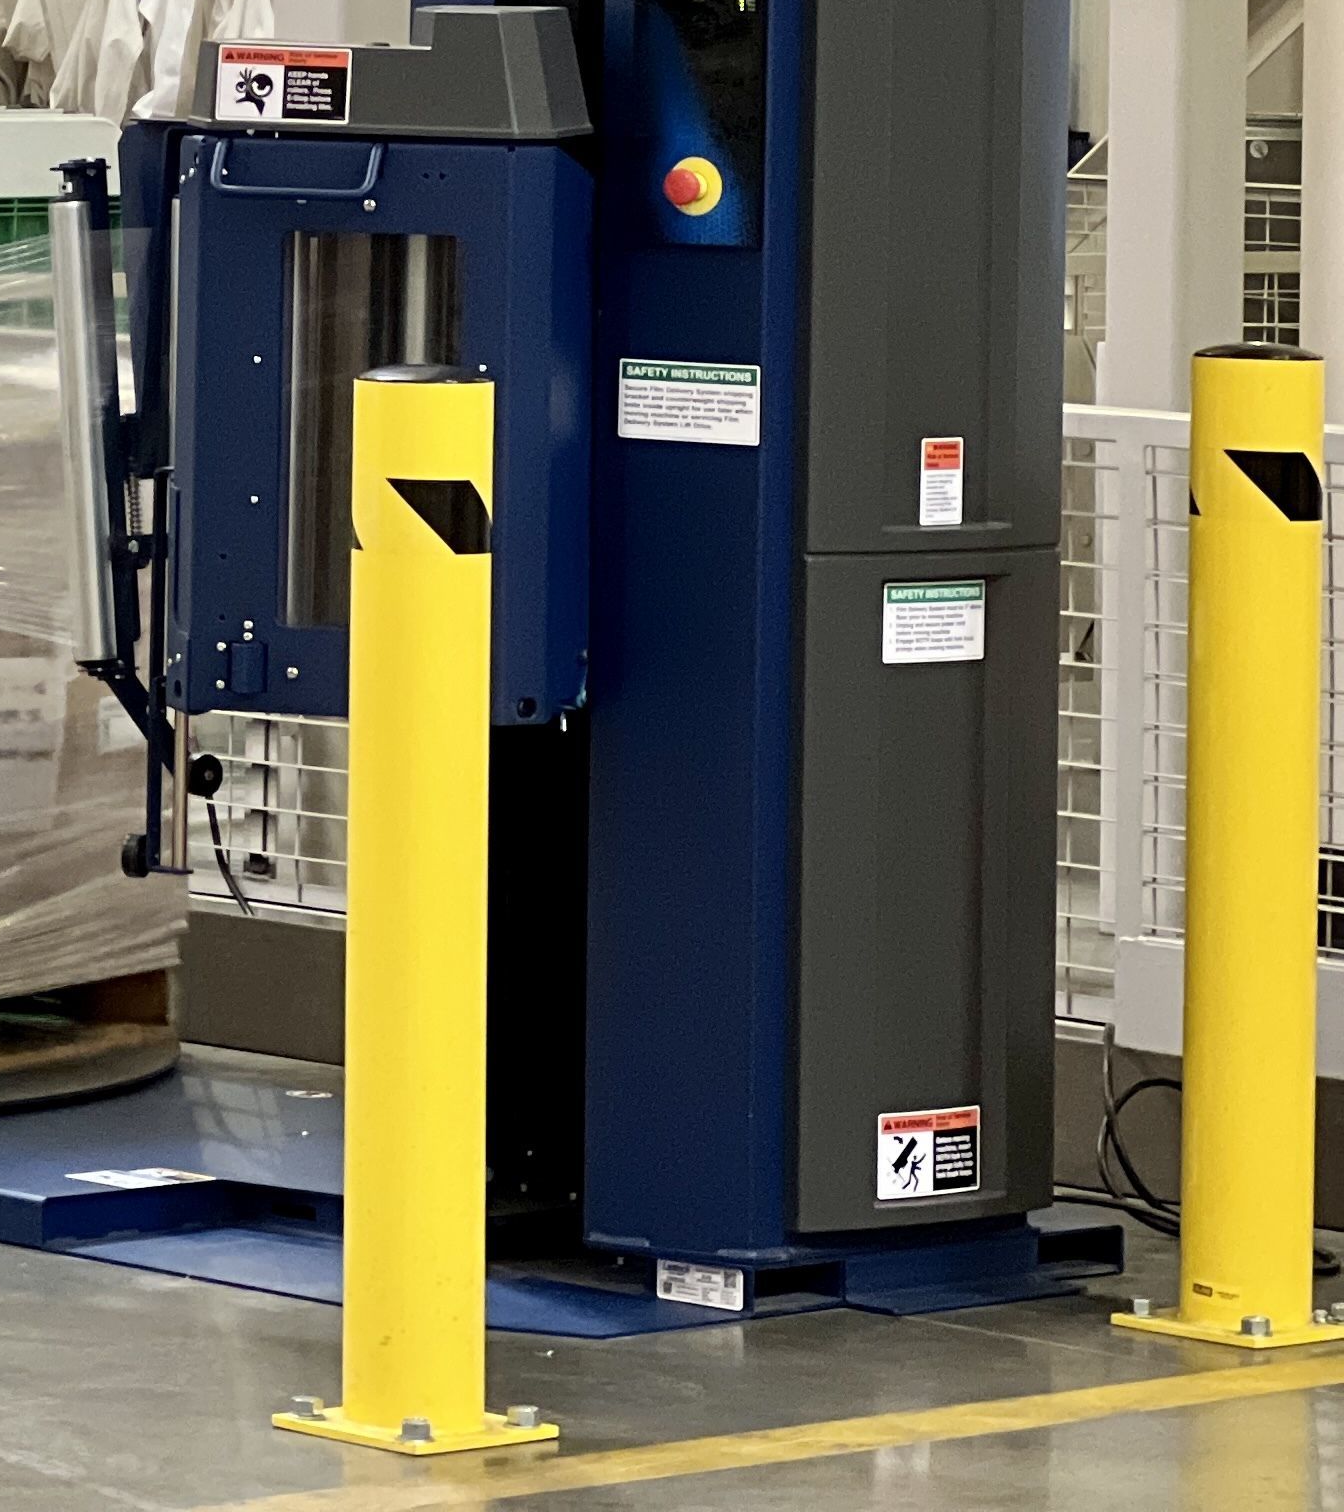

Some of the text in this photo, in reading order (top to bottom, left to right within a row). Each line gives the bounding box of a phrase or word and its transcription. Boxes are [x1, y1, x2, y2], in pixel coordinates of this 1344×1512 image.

[237, 51, 284, 62] WARNING
[626, 365, 752, 382] SAFETY INSTRUCTIONS
[891, 587, 980, 600] SAFETY INSTRUCTIONS
[894, 1118, 932, 1129] WARNING
